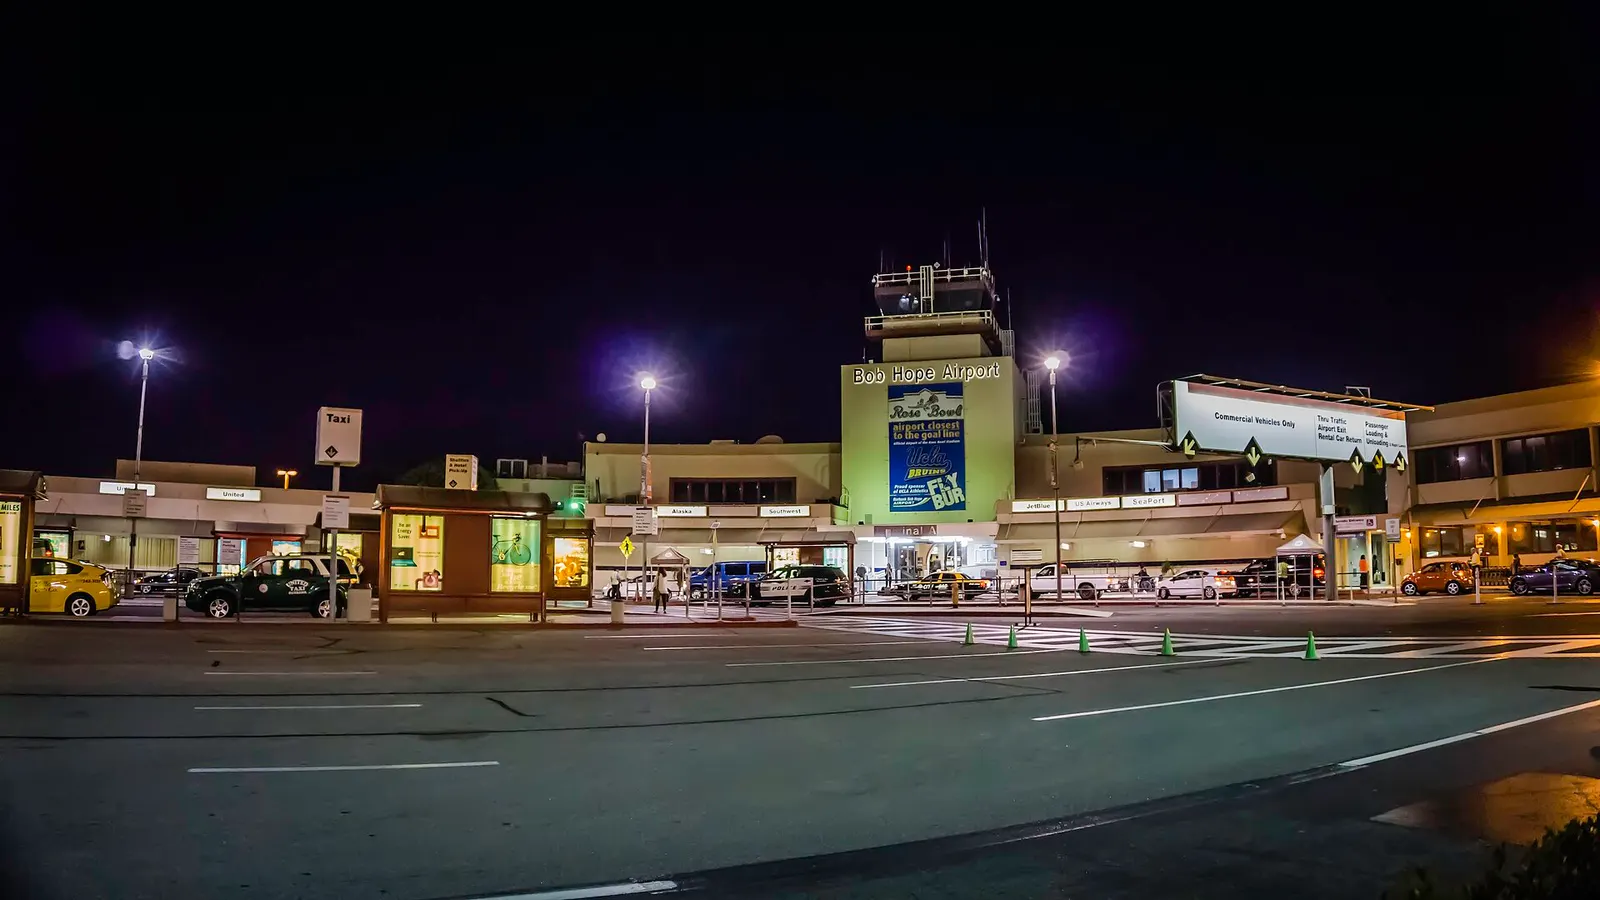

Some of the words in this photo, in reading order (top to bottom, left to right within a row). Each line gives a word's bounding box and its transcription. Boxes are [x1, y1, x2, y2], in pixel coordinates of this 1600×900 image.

[853, 368, 885, 384] Bob
[892, 366, 935, 383] Hope
[942, 362, 1000, 380] Airport
[890, 406, 920, 418] Rose
[928, 404, 962, 418] Bowl
[326, 413, 350, 423] Taxi
[1214, 412, 1253, 423] Commercial
[1254, 416, 1280, 426] Vehicles
[1282, 420, 1295, 428] Only
[893, 422, 924, 434] airport
[928, 421, 959, 430] closest
[1318, 424, 1336, 432] Airport
[1365, 421, 1388, 430] Passenger
[904, 430, 919, 439] the
[921, 430, 941, 440] goal
[943, 429, 960, 438] line
[1366, 430, 1383, 438] Loading
[1366, 438, 1388, 447] Unloading
[908, 468, 946, 478] BRUINS
[932, 488, 966, 510] BUR
[930, 526, 936, 535] A
